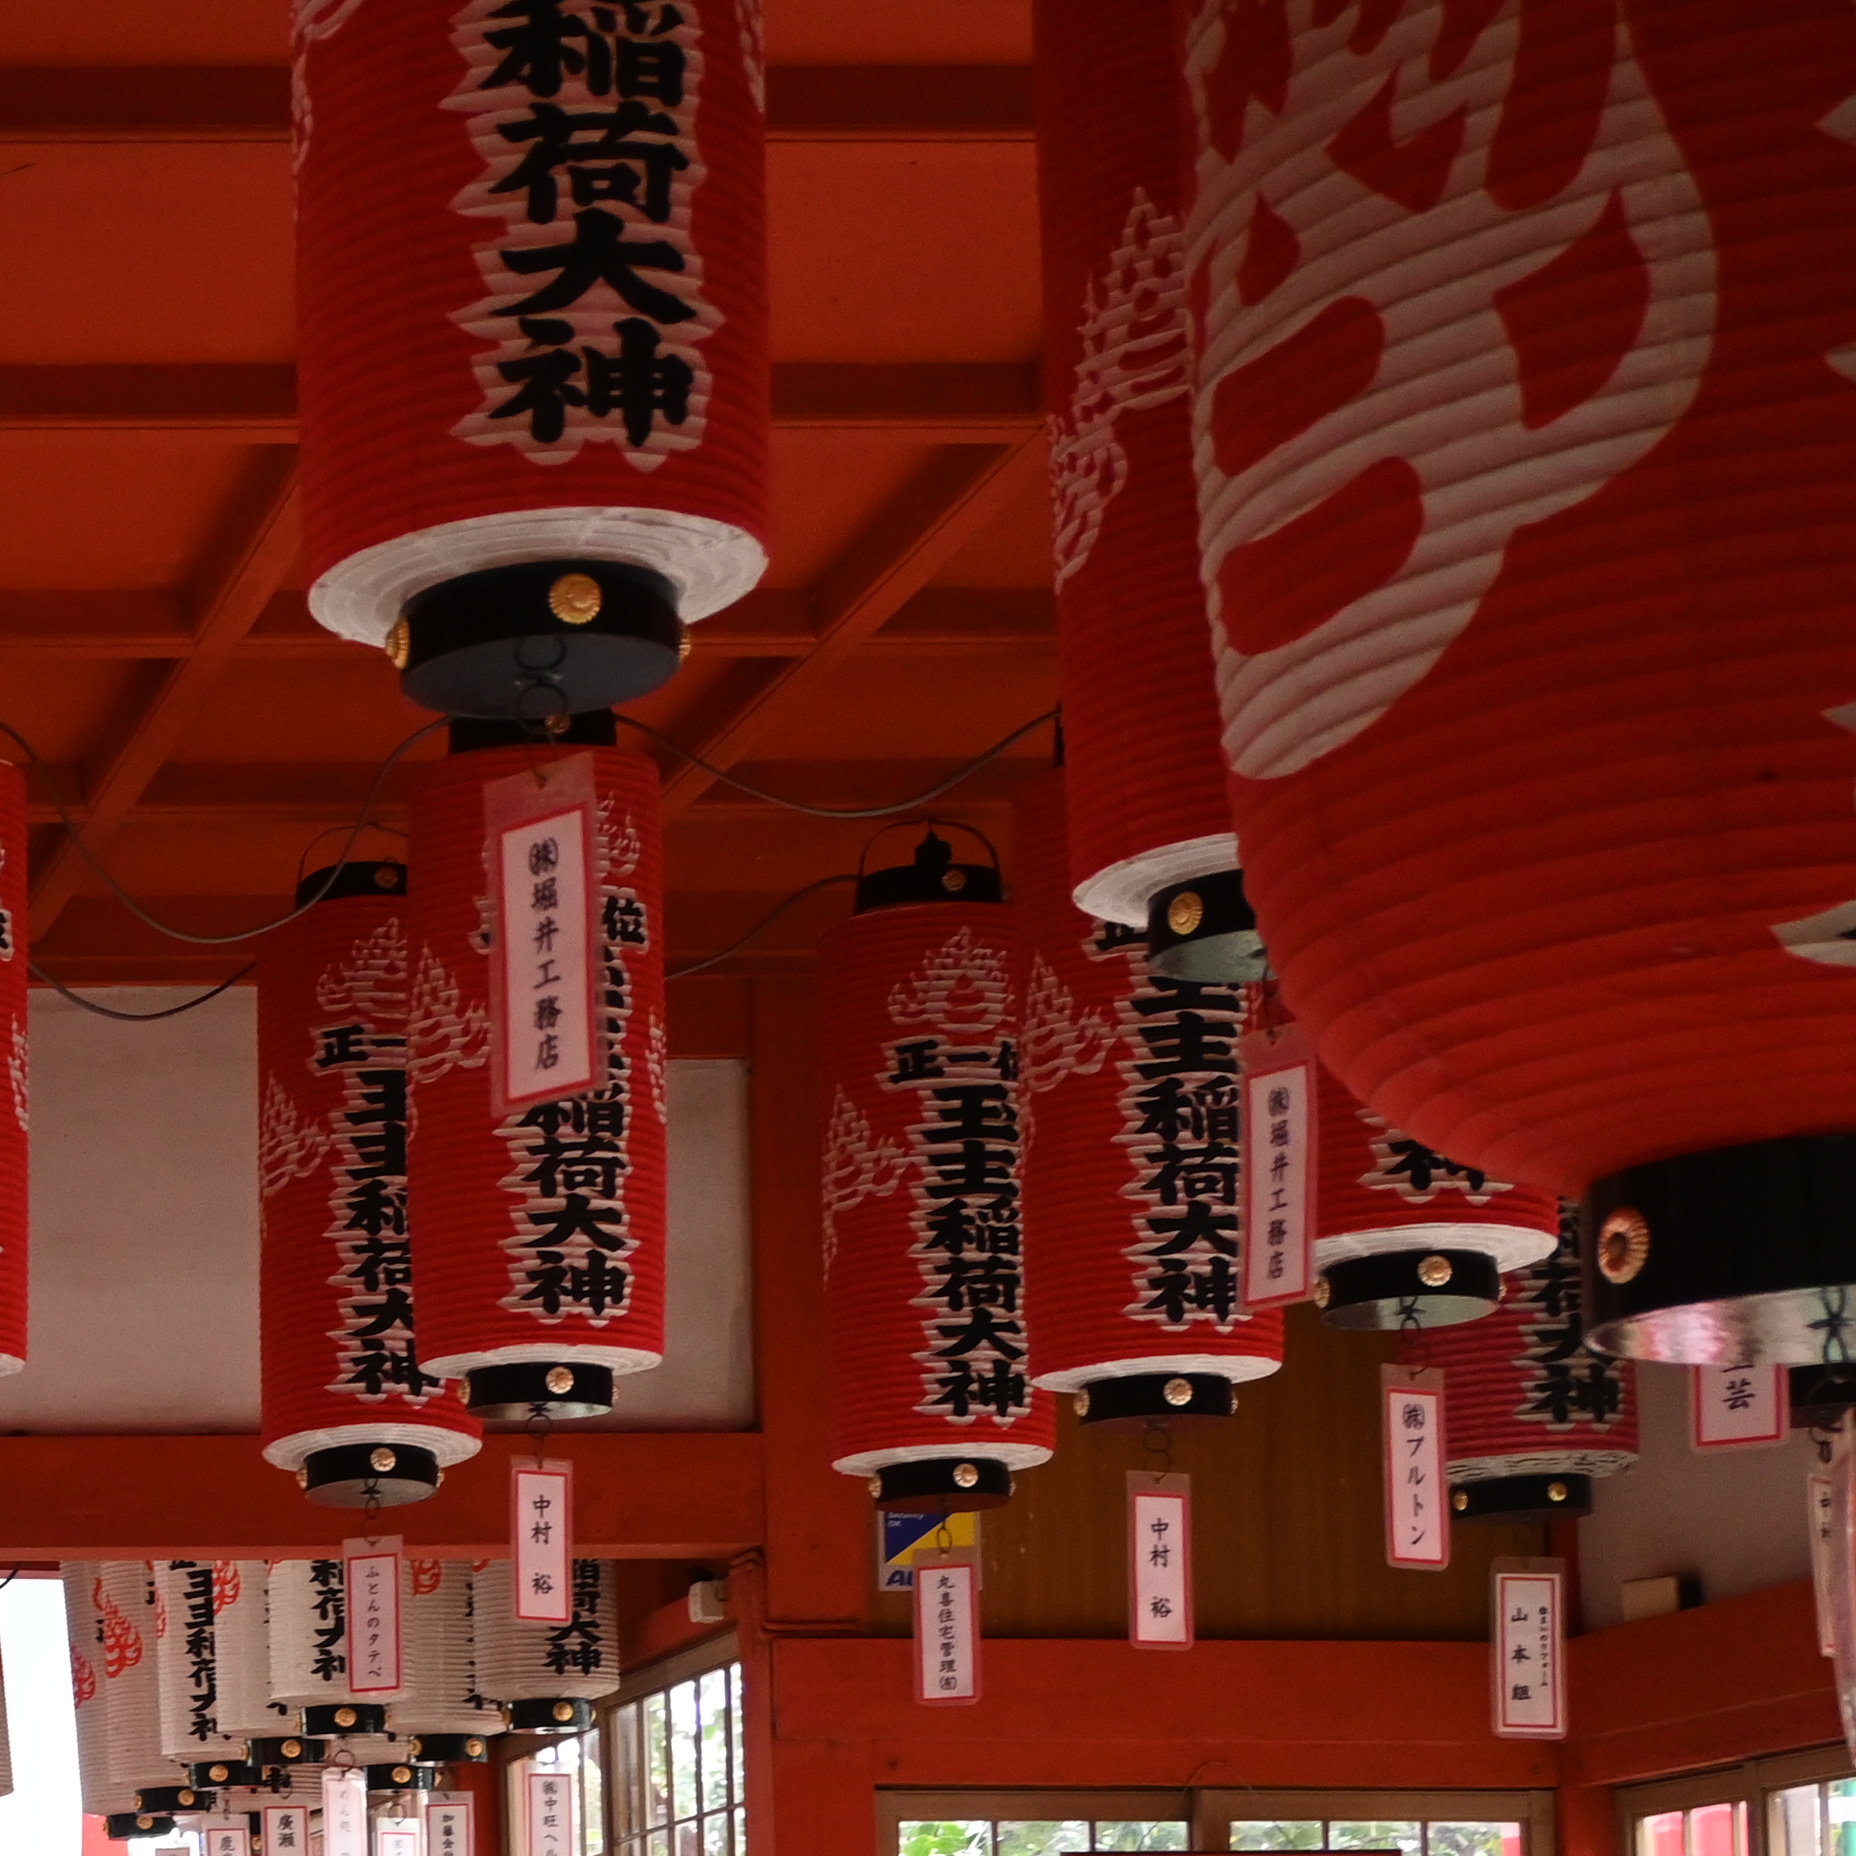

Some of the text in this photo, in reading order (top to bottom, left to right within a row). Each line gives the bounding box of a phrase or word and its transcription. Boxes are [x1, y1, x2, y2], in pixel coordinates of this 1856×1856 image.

[922, 1088, 1025, 1418] 玉主稲荷大神
[531, 1494, 553, 1545] 中村
[1149, 1518, 1171, 1569] 中村
